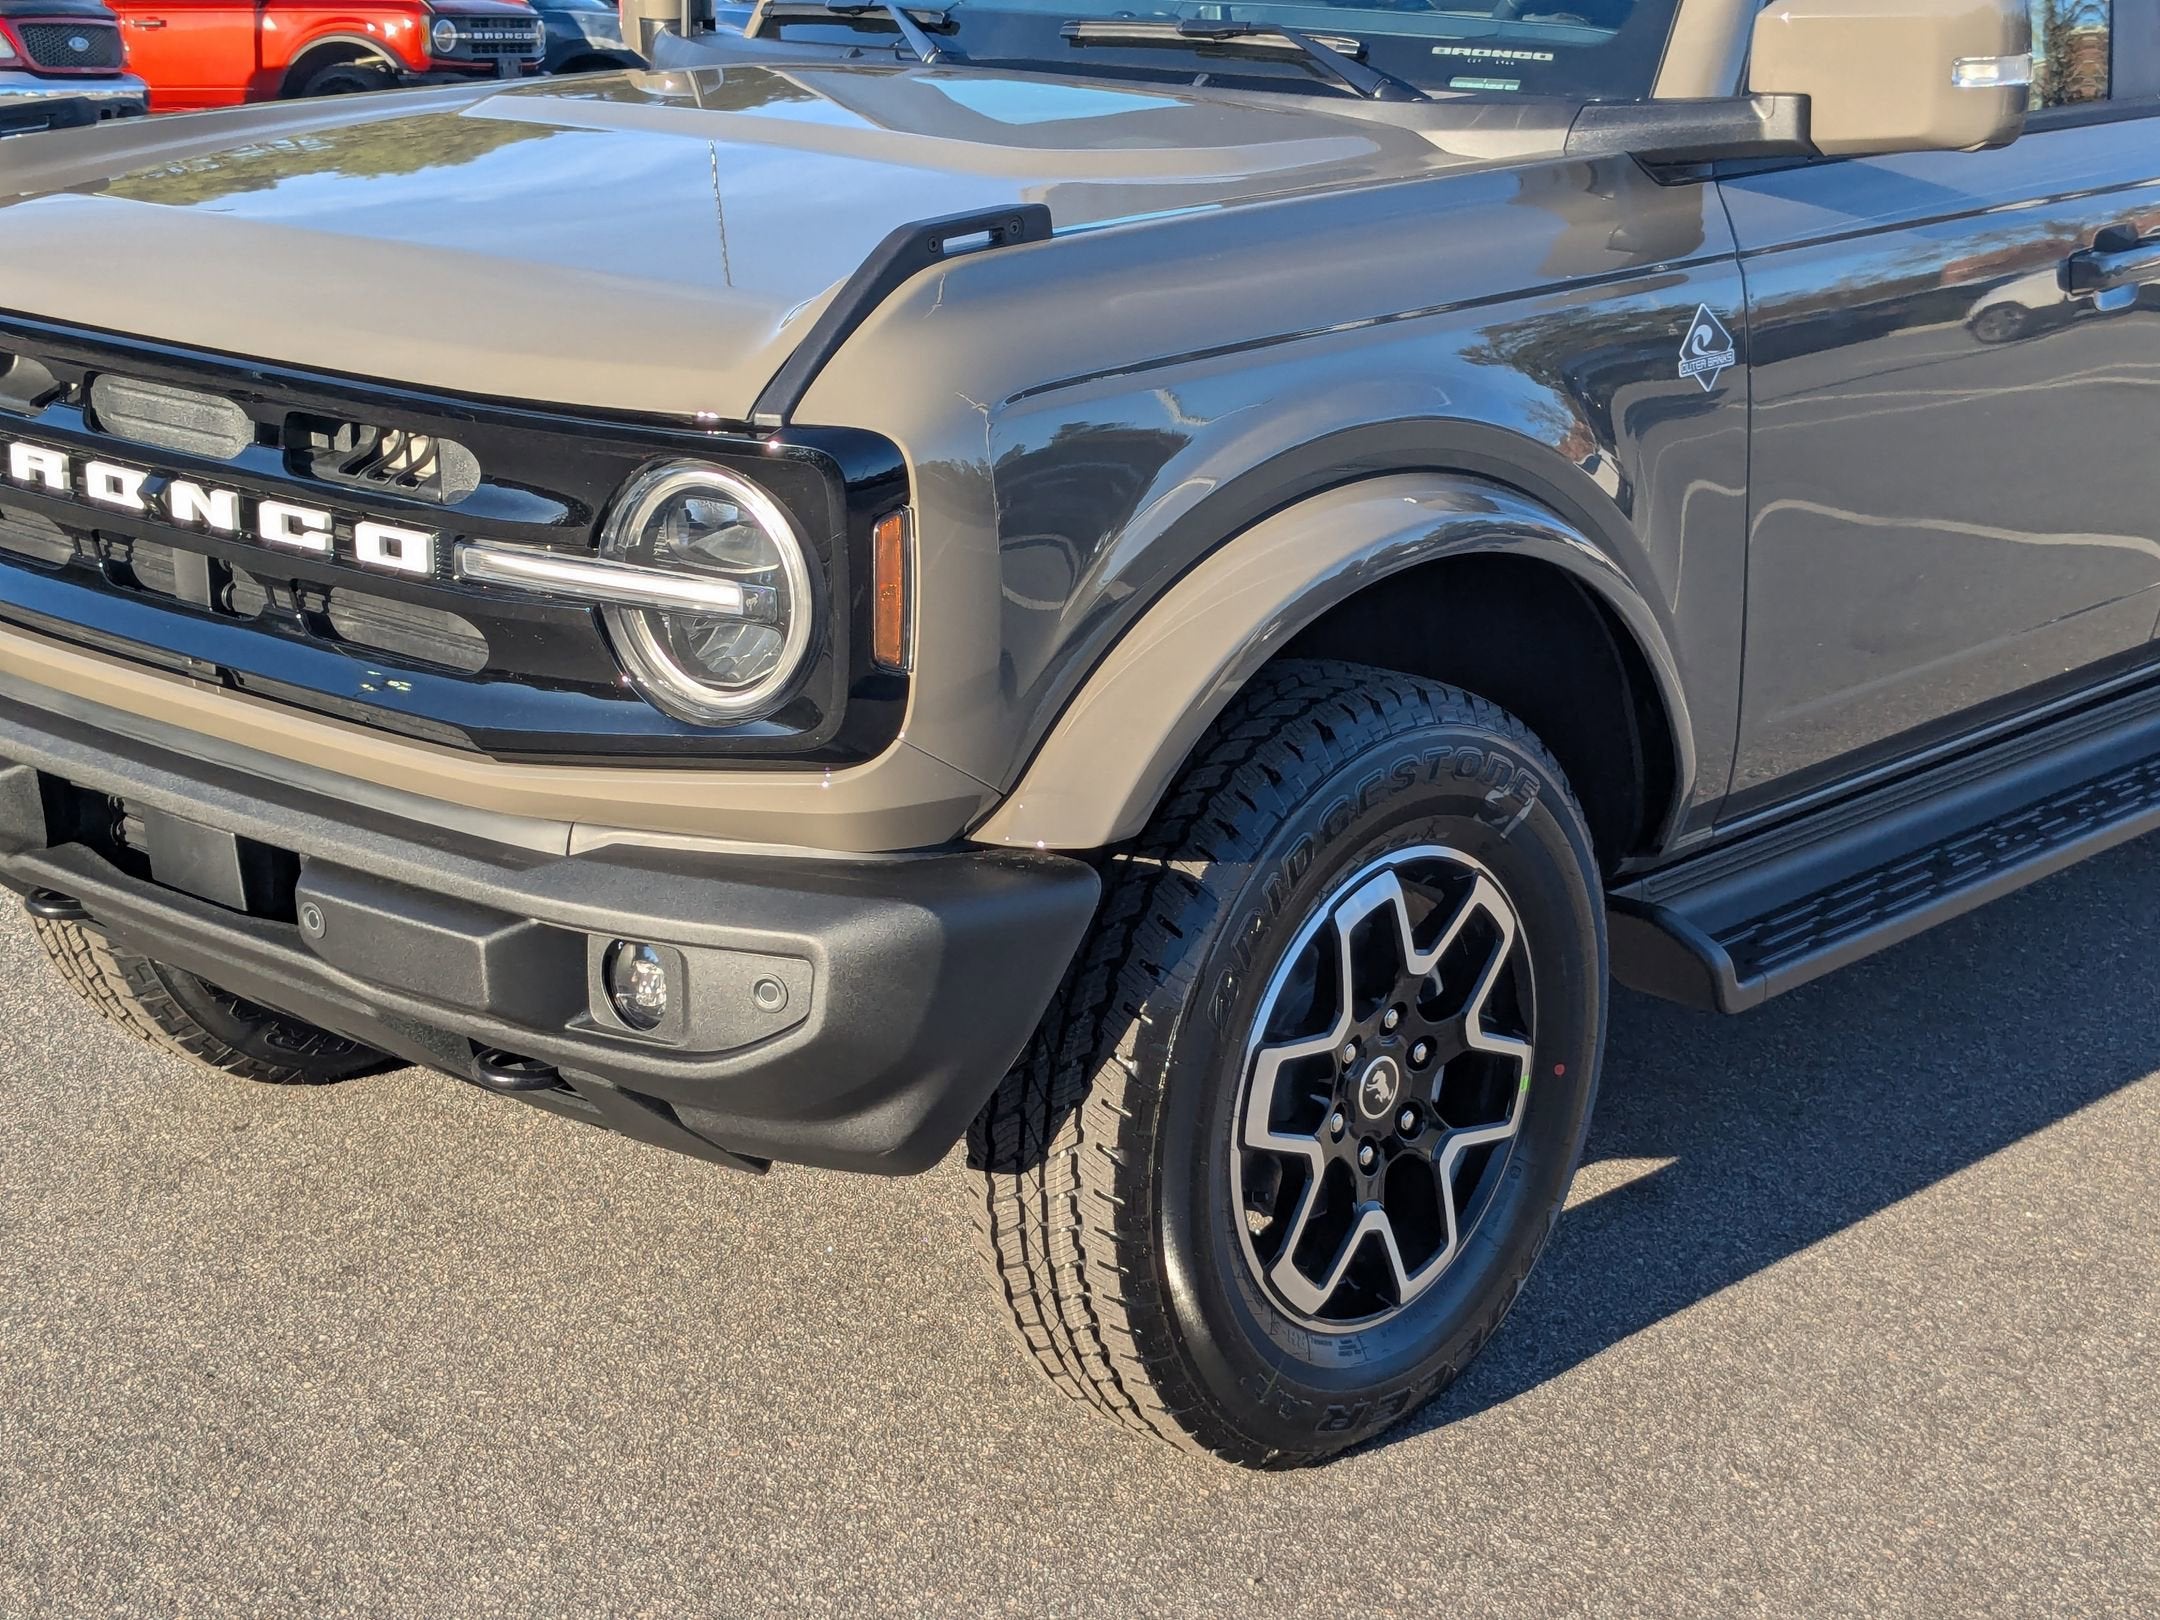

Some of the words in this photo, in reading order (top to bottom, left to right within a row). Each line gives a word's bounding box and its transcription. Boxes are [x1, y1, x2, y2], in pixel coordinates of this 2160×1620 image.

[1681, 359, 1707, 374] OUTER
[1707, 352, 1733, 367] BANKS
[9, 441, 437, 577] RONCO
